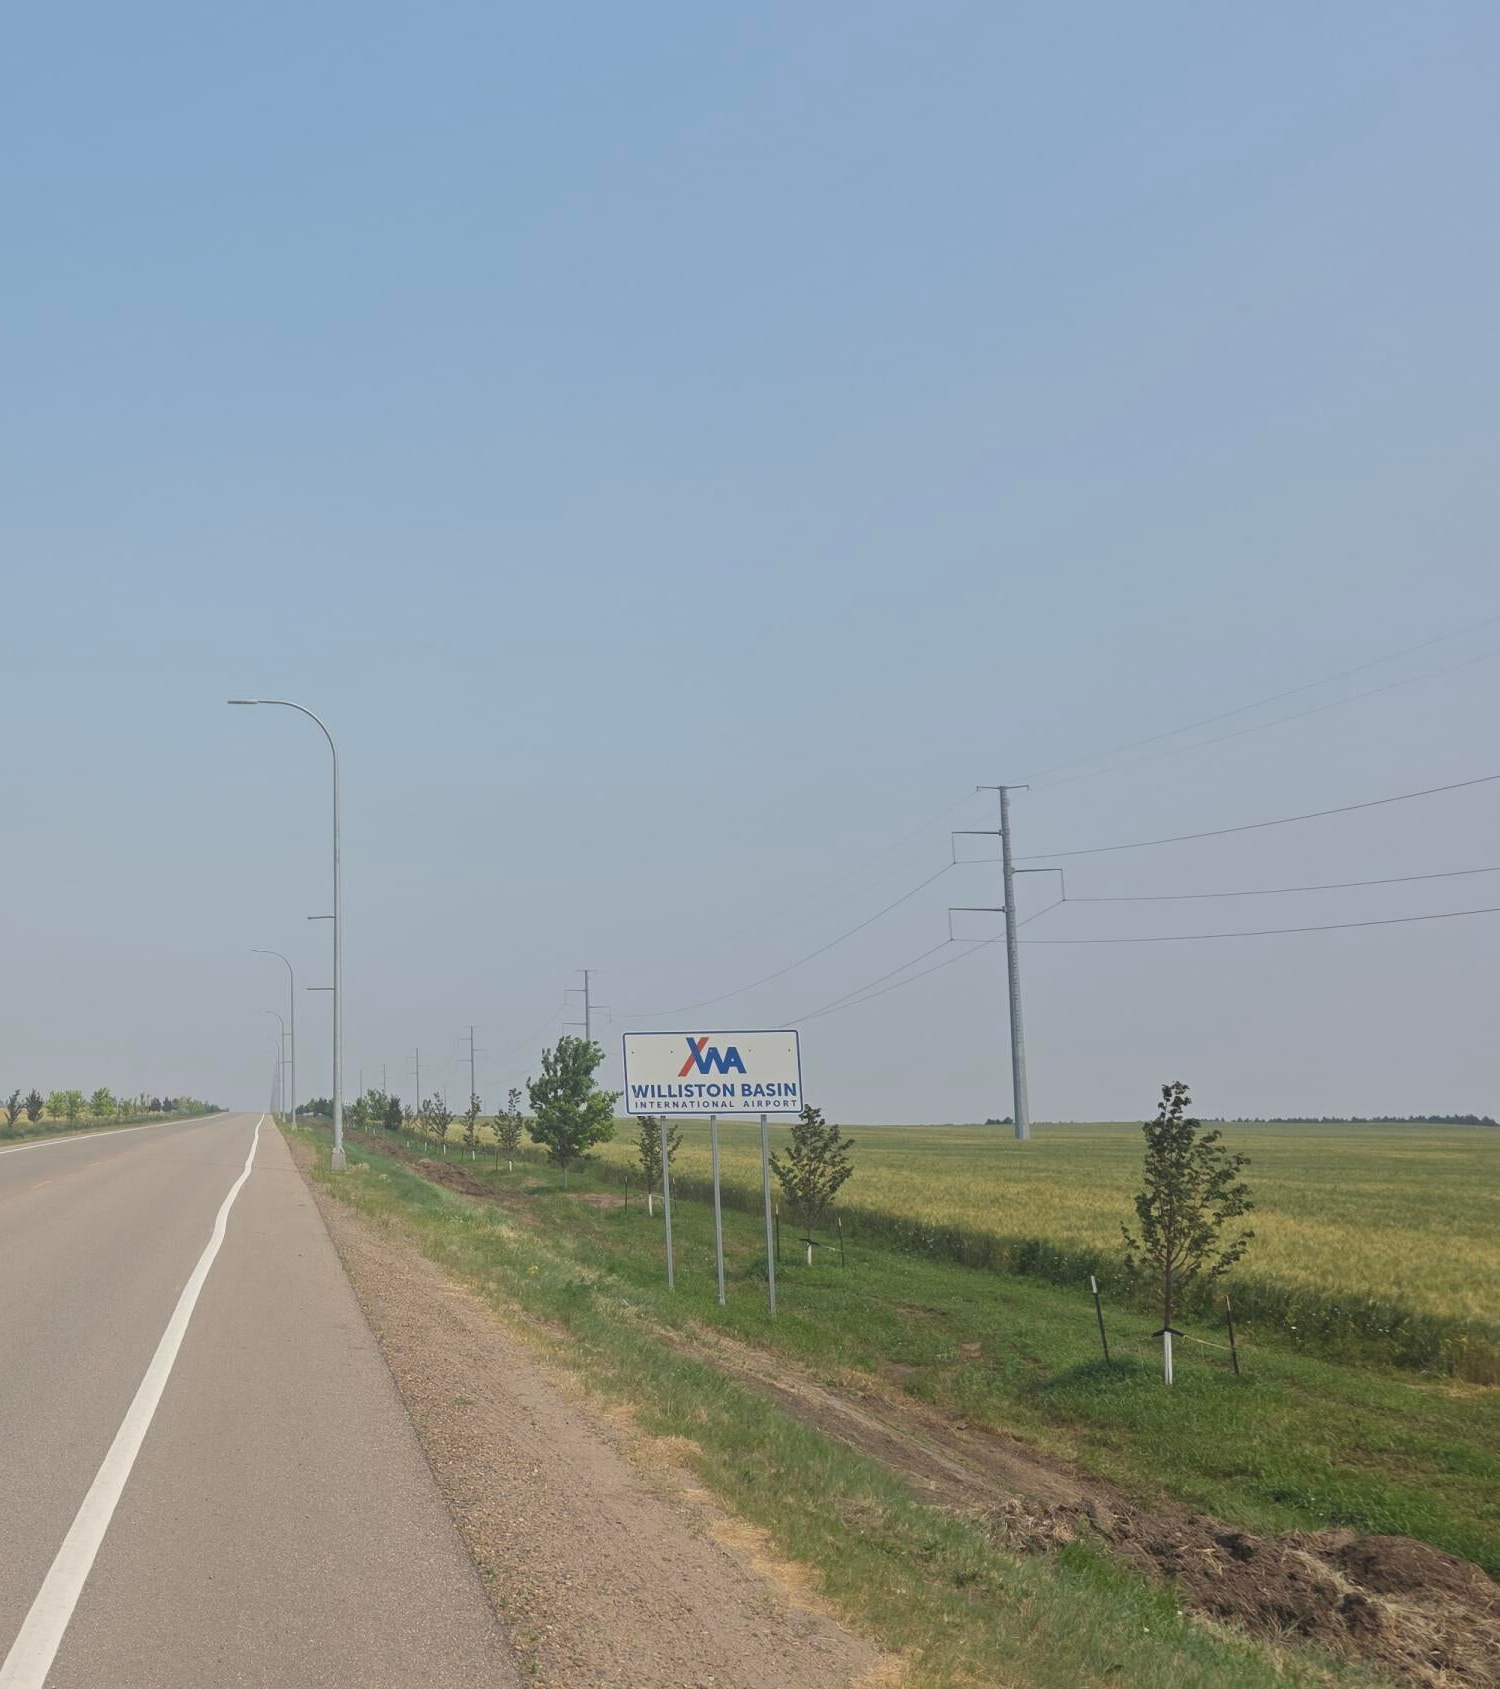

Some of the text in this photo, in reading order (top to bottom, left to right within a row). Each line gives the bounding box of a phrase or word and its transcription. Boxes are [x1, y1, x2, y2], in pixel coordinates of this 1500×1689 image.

[631, 1083, 797, 1098] WILLISTON BASIN
[635, 1100, 797, 1109] INTERNATIONAL AIRPORT
